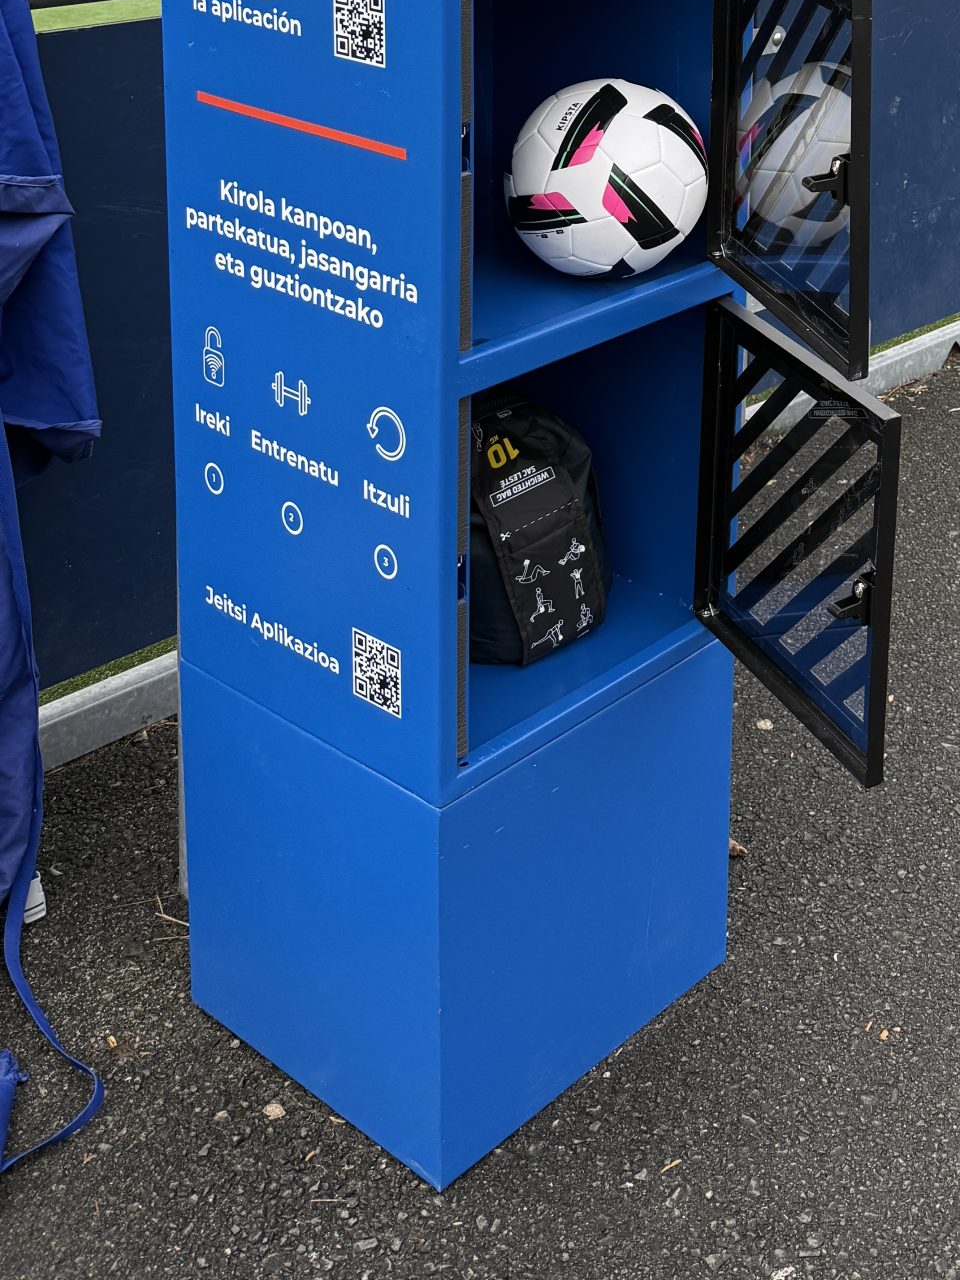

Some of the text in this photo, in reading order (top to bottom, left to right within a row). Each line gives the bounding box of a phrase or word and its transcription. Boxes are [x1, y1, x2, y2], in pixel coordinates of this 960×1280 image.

[211, 0, 302, 37] aplicación
[555, 101, 580, 132] KIPSTA
[220, 179, 377, 256] Kirola kanpoan,
[186, 206, 418, 304] partekatua, jasangarria
[214, 252, 384, 329] eta guztiontzako
[487, 437, 520, 469] 10
[489, 434, 500, 445] KG
[195, 403, 410, 519] Ireki Entrenatu Itzuli
[499, 464, 537, 489] SAC LESTÉ
[496, 471, 550, 502] WEIGHTED BAG
[205, 585, 340, 675] Jeitsi Aplikazioa
